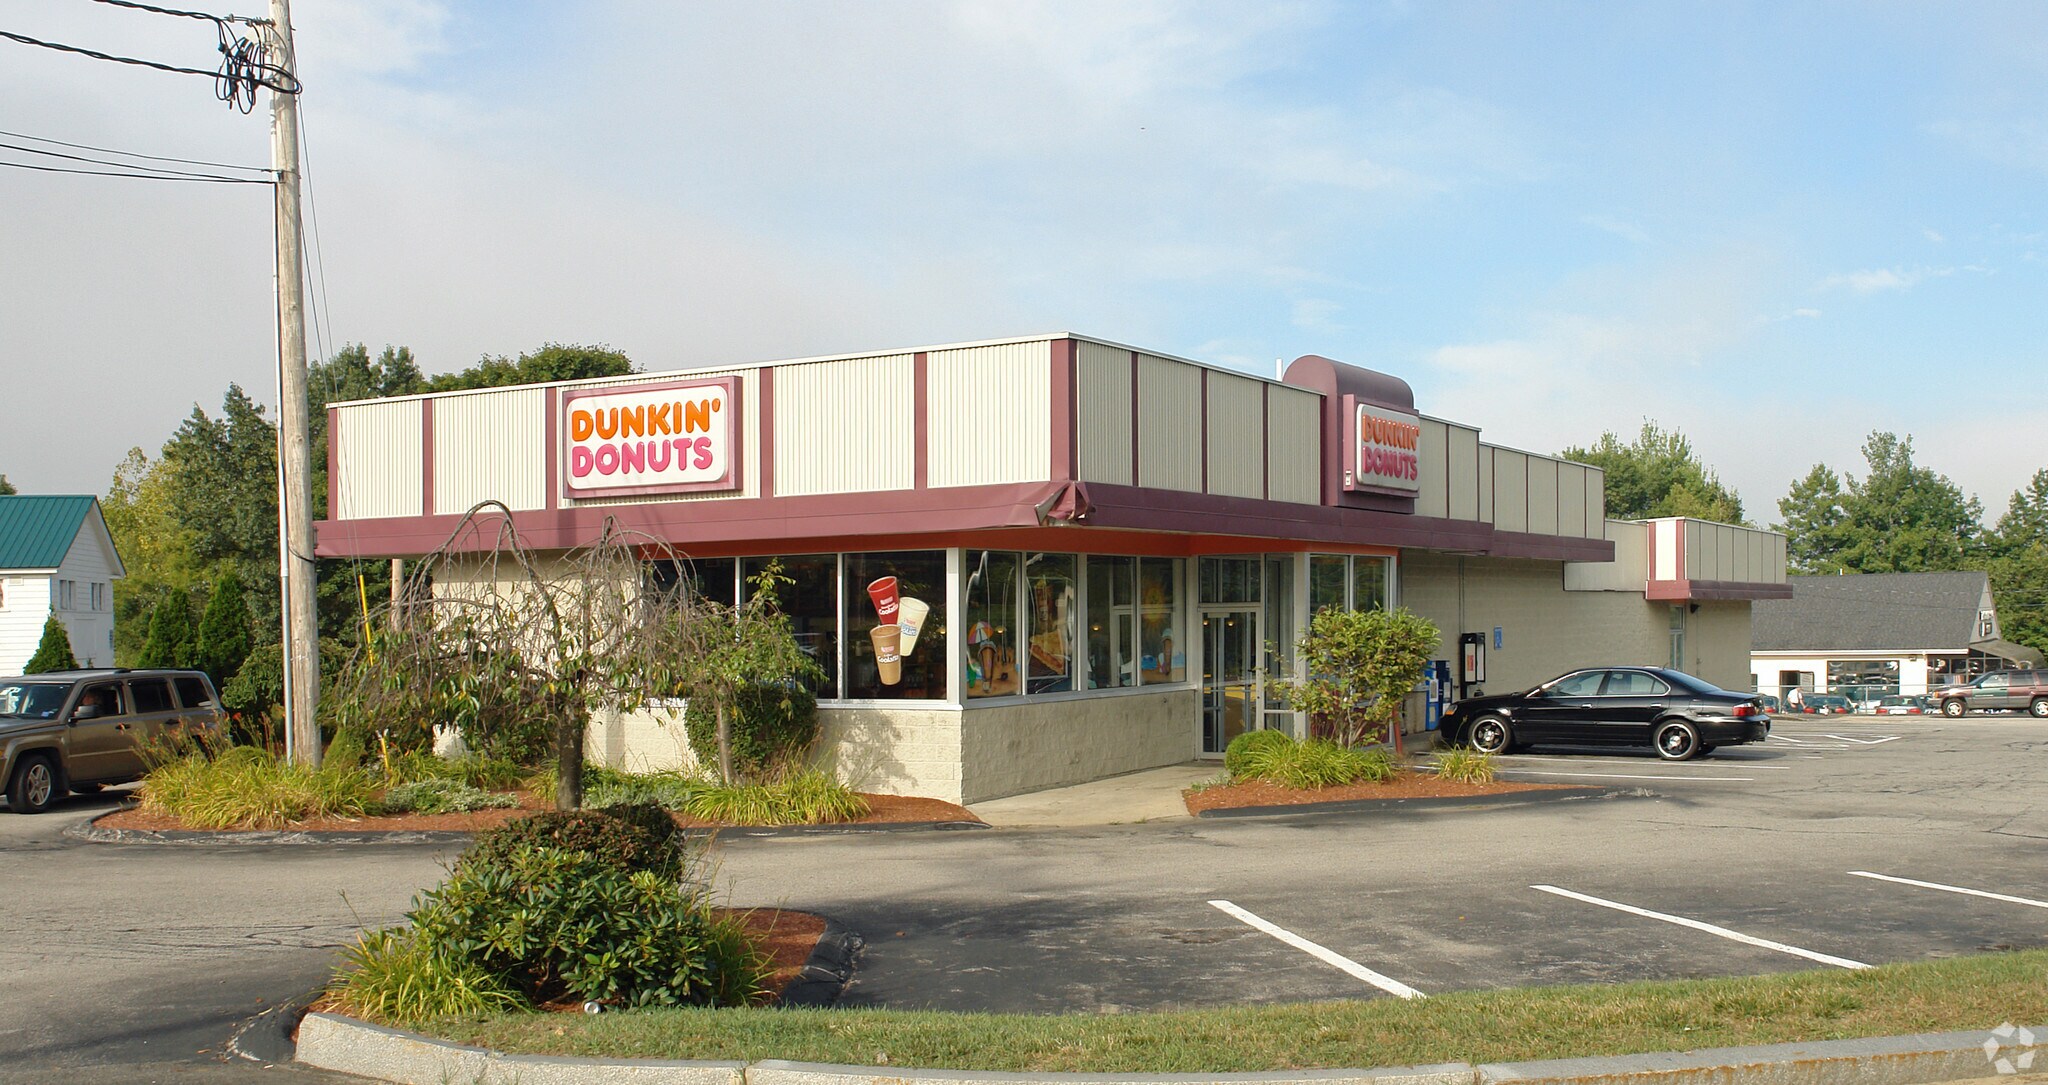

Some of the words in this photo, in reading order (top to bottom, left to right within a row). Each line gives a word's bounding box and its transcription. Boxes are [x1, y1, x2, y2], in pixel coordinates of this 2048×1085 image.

[572, 398, 721, 442] DUNKIN'
[1362, 414, 1419, 451] DUNKIN'
[572, 437, 713, 478] DONUTS
[1362, 446, 1418, 481] DONUTS
